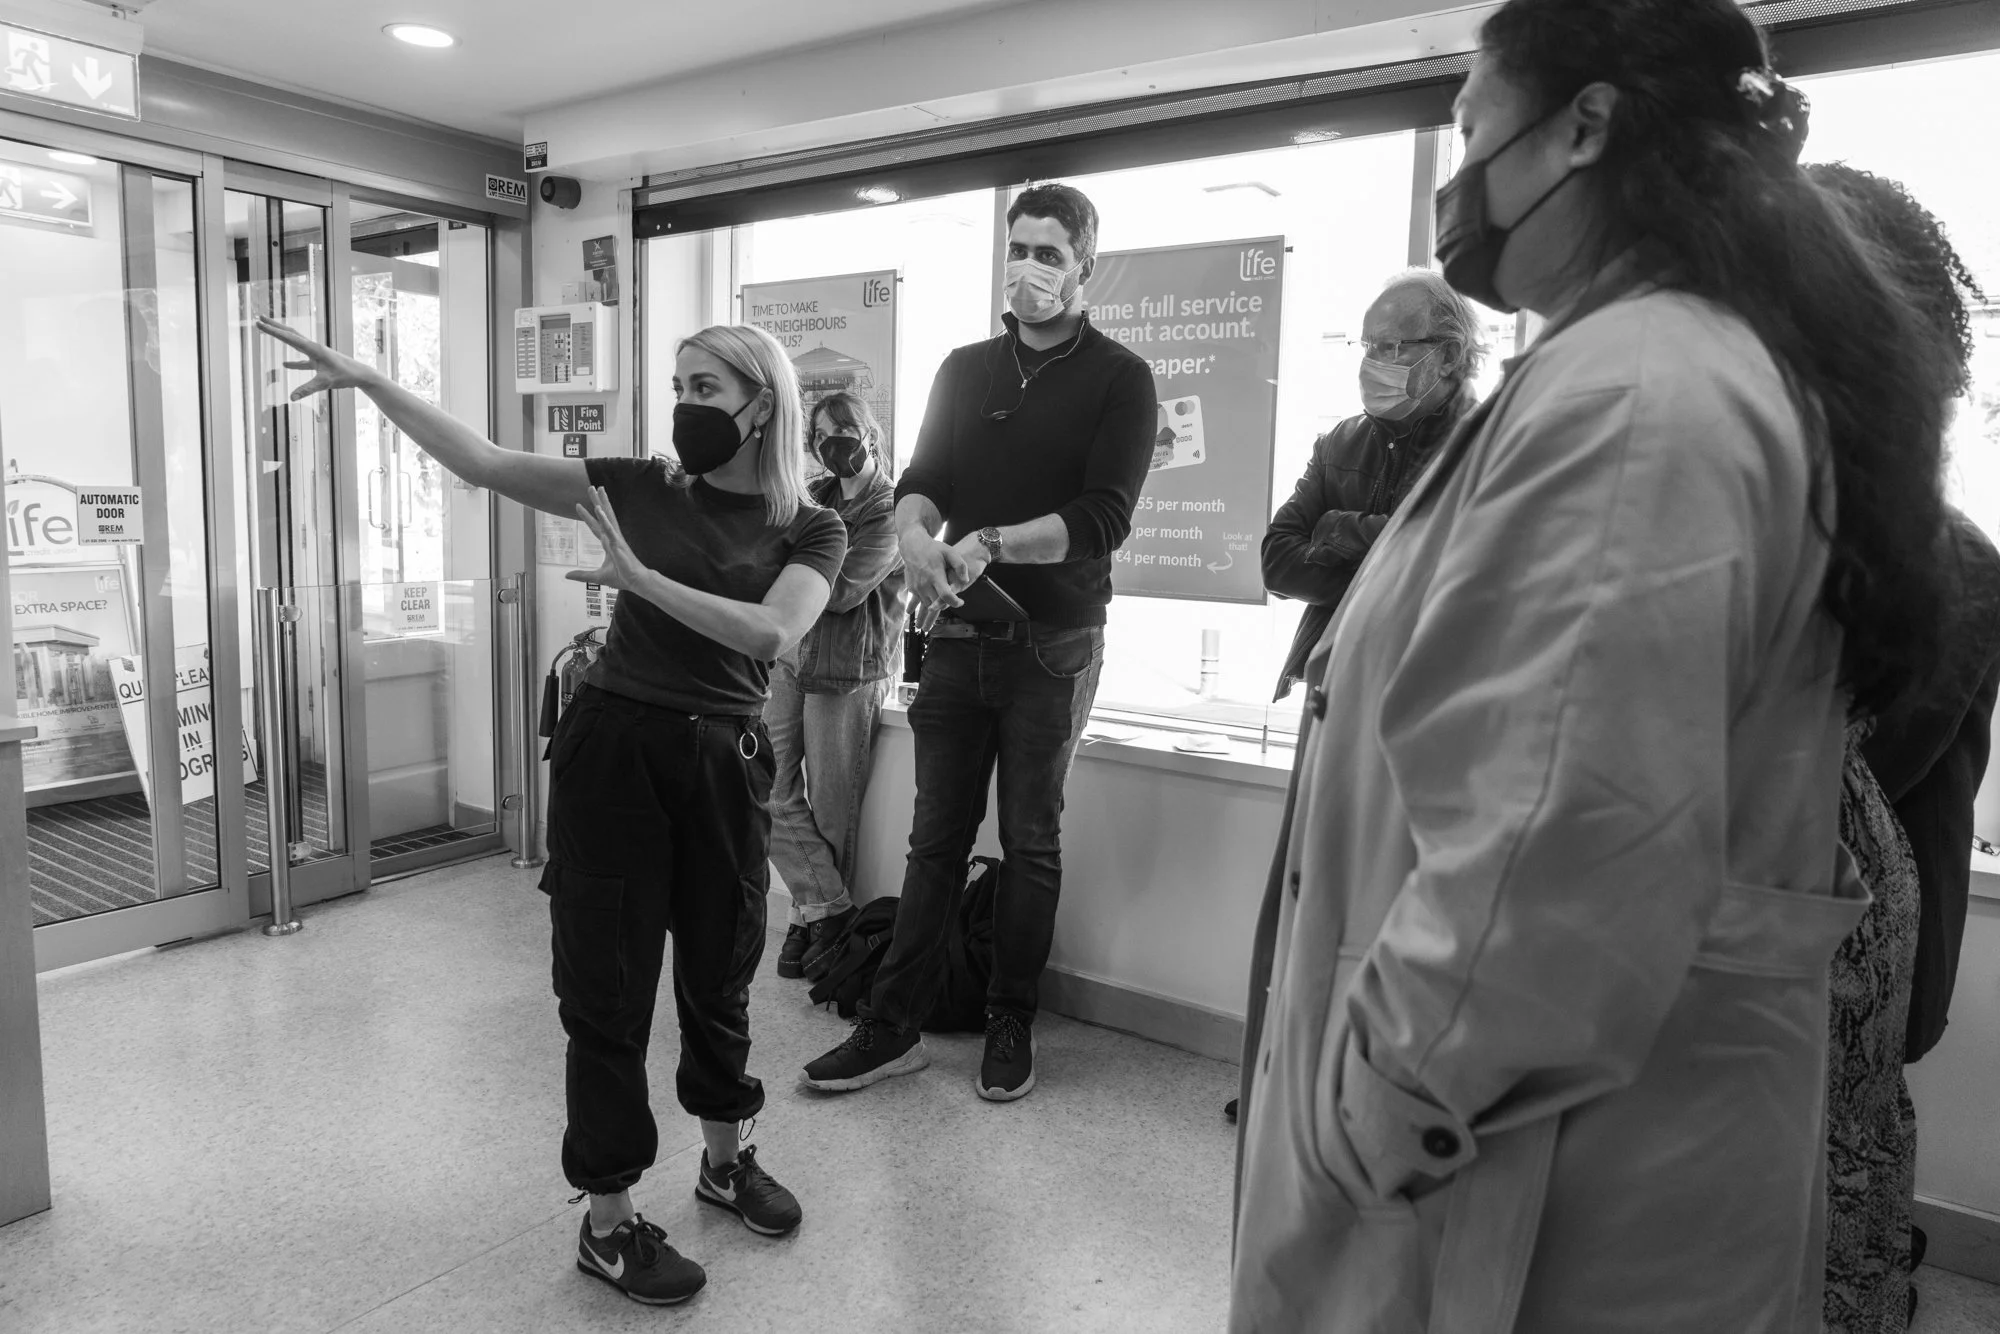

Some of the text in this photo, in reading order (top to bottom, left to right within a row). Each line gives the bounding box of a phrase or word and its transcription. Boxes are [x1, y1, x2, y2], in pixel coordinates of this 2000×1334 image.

[498, 180, 526, 197] REM
[1240, 248, 1276, 281] Life
[863, 279, 890, 307] Life
[752, 301, 818, 316] TIME TO MAKE
[1140, 294, 1174, 318] full
[1180, 290, 1262, 317] service
[774, 316, 847, 332] NEIGHBOURS
[1159, 317, 1256, 341] account.
[776, 334, 803, 348] OUS?
[1147, 355, 1216, 379] eaper.
[580, 406, 599, 417] Fire
[577, 419, 602, 430] Point
[80, 494, 139, 504] AUTOMATIC
[1136, 497, 1225, 512] 55 per month
[96, 508, 125, 518] DOOR
[6, 499, 73, 556] ife
[1135, 527, 1158, 539] per
[1160, 526, 1203, 540] month
[1222, 532, 1253, 541] Look at
[1228, 543, 1248, 551] that!
[1115, 550, 1202, 568] €4 per month
[404, 587, 428, 598] KEEP
[15, 600, 108, 615] EXTRA SPACE?
[401, 599, 431, 611] CLEAR
[119, 680, 143, 698] QU
[60, 703, 109, 714] IMPROVEMENT
[182, 731, 203, 752] IN
